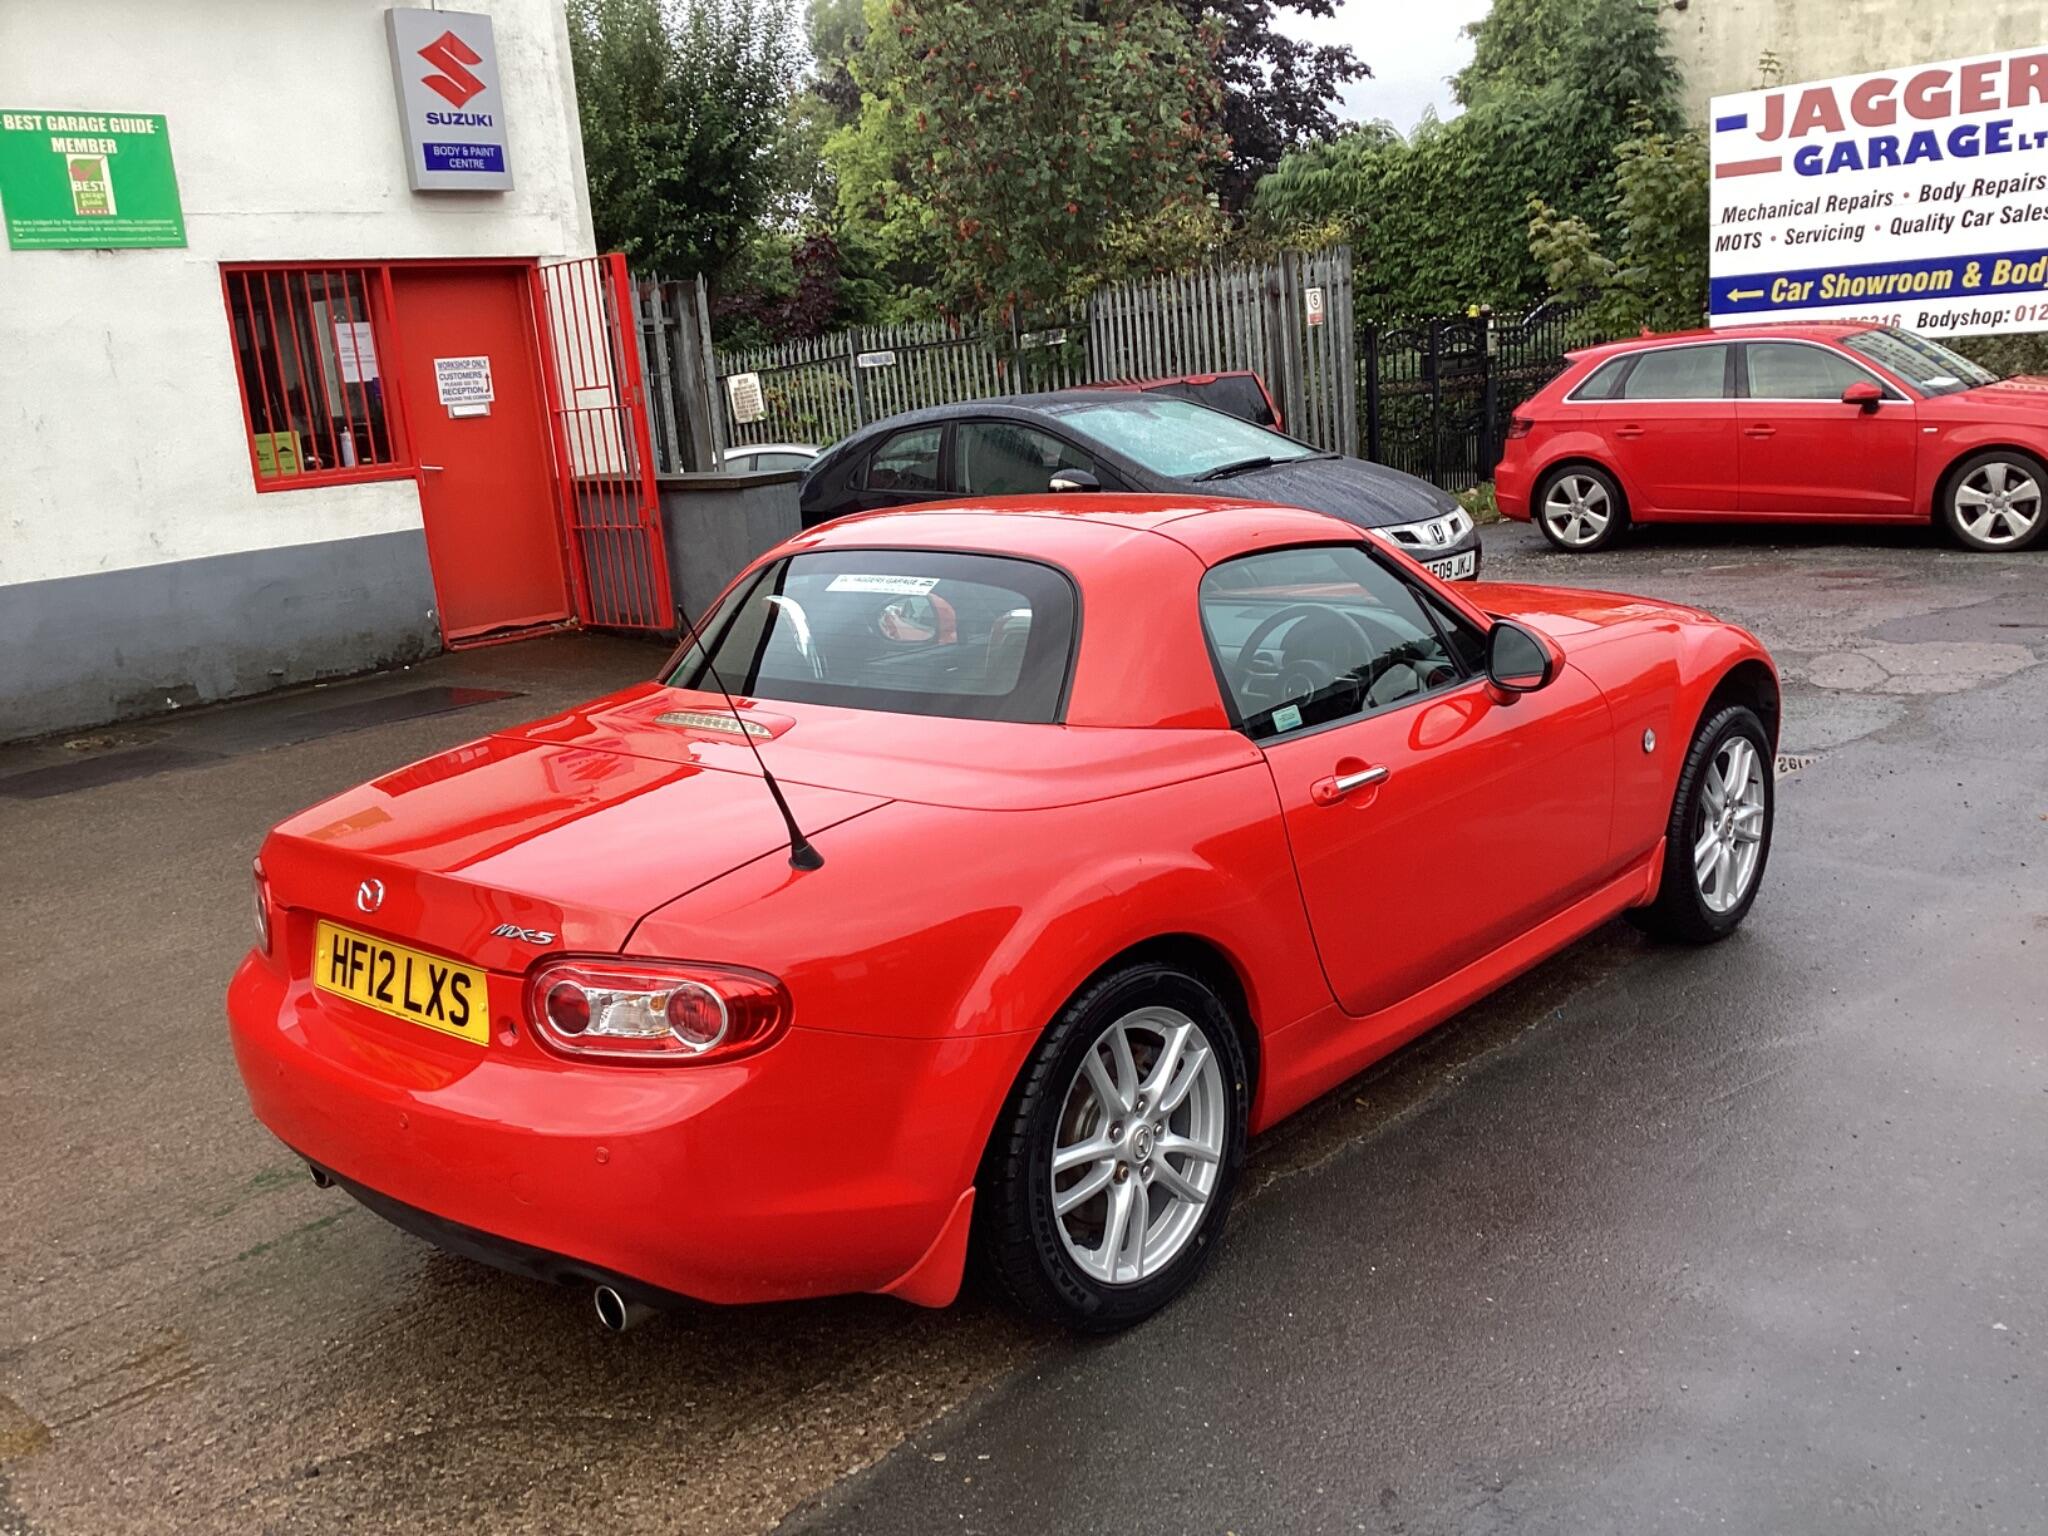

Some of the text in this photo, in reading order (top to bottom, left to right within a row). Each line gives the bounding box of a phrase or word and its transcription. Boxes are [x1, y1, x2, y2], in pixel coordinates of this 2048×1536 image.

[1756, 53, 2048, 141] JAGGER
[3, 114, 155, 134] BEST GARAGE GUIDE
[426, 112, 493, 127] SUZUKI
[51, 137, 118, 154] MEMBER
[433, 146, 495, 157] BODY & PAINT
[1793, 118, 2013, 177] GARAGE
[449, 158, 485, 169] CENTRE
[73, 181, 105, 192] BEST
[1721, 172, 2047, 224] Mechanical Repairs Body Repairs
[1715, 203, 2048, 252] MOTS Servicing Quality Car Sales
[1771, 256, 2048, 303] Car Showroom & Bod
[1916, 308, 2011, 330] Bodyshop:
[439, 371, 482, 380] CUSTOMERS
[442, 387, 484, 395] RECEPTION
[1454, 555, 1472, 576] JKJ
[491, 923, 556, 945] MX-5
[331, 934, 472, 1027] HF12 LXS
